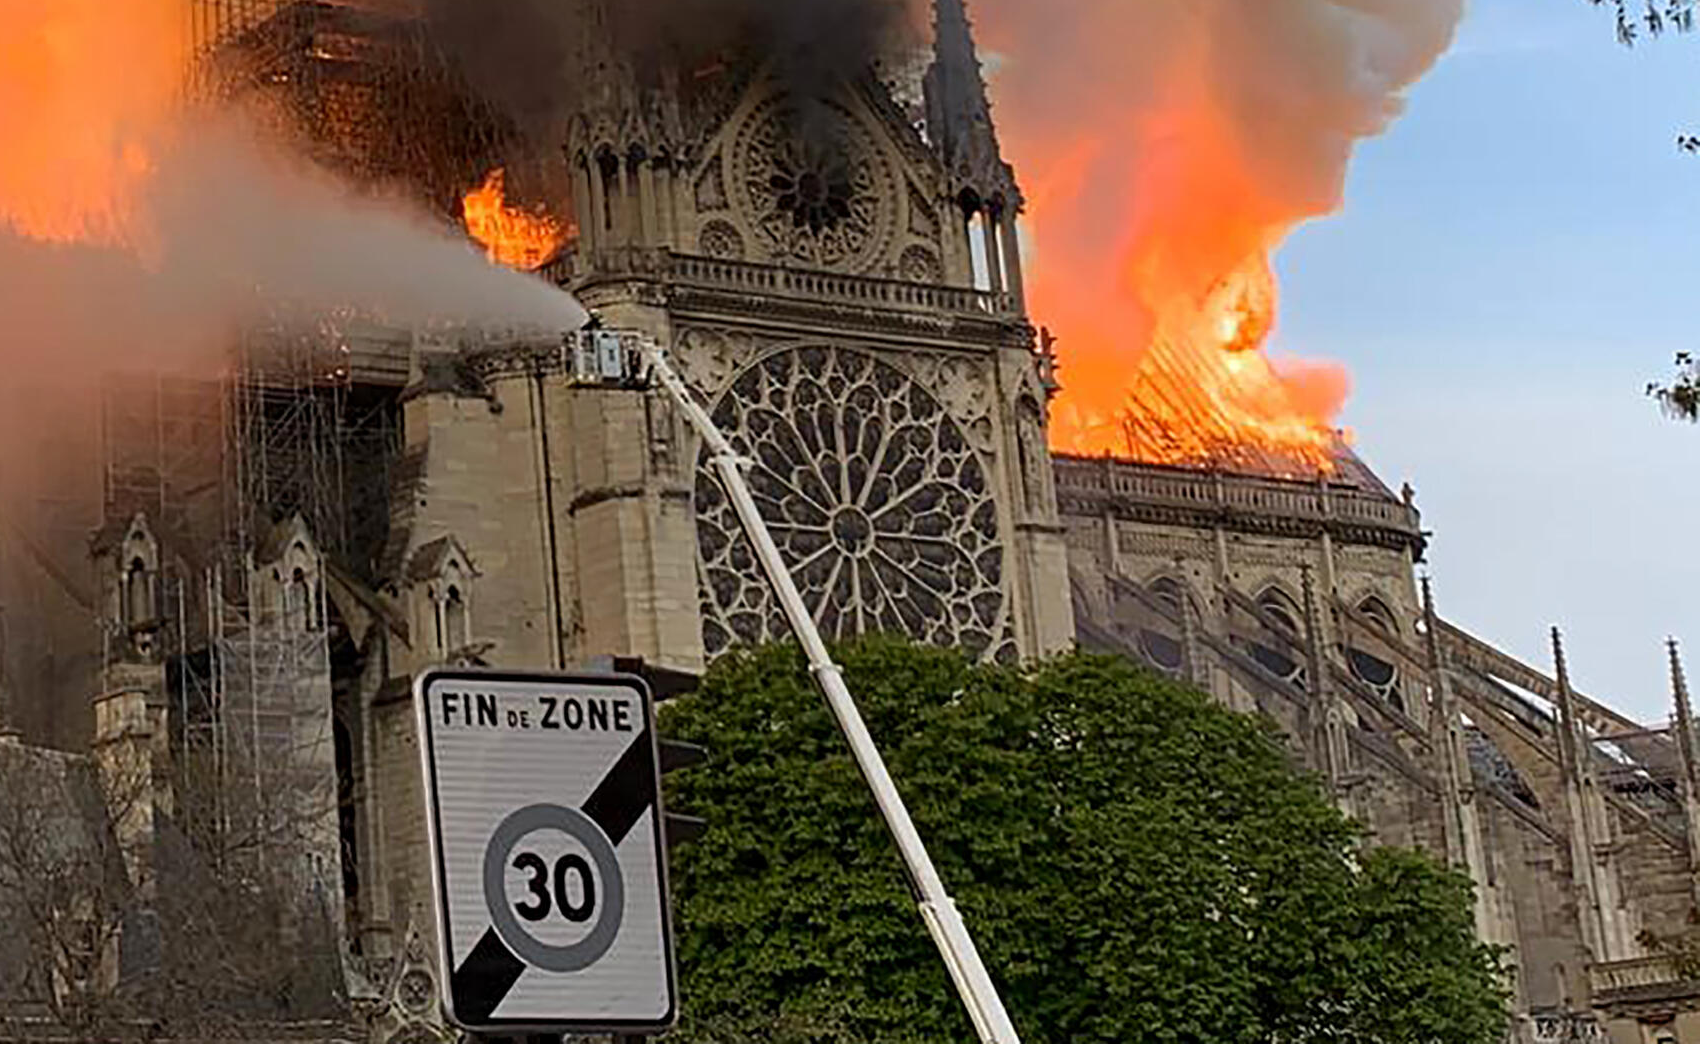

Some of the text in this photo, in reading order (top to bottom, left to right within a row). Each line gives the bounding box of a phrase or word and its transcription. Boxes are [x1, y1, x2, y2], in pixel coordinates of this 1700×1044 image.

[441, 692, 633, 732] FIN DE ZONE
[512, 852, 596, 923] 30
